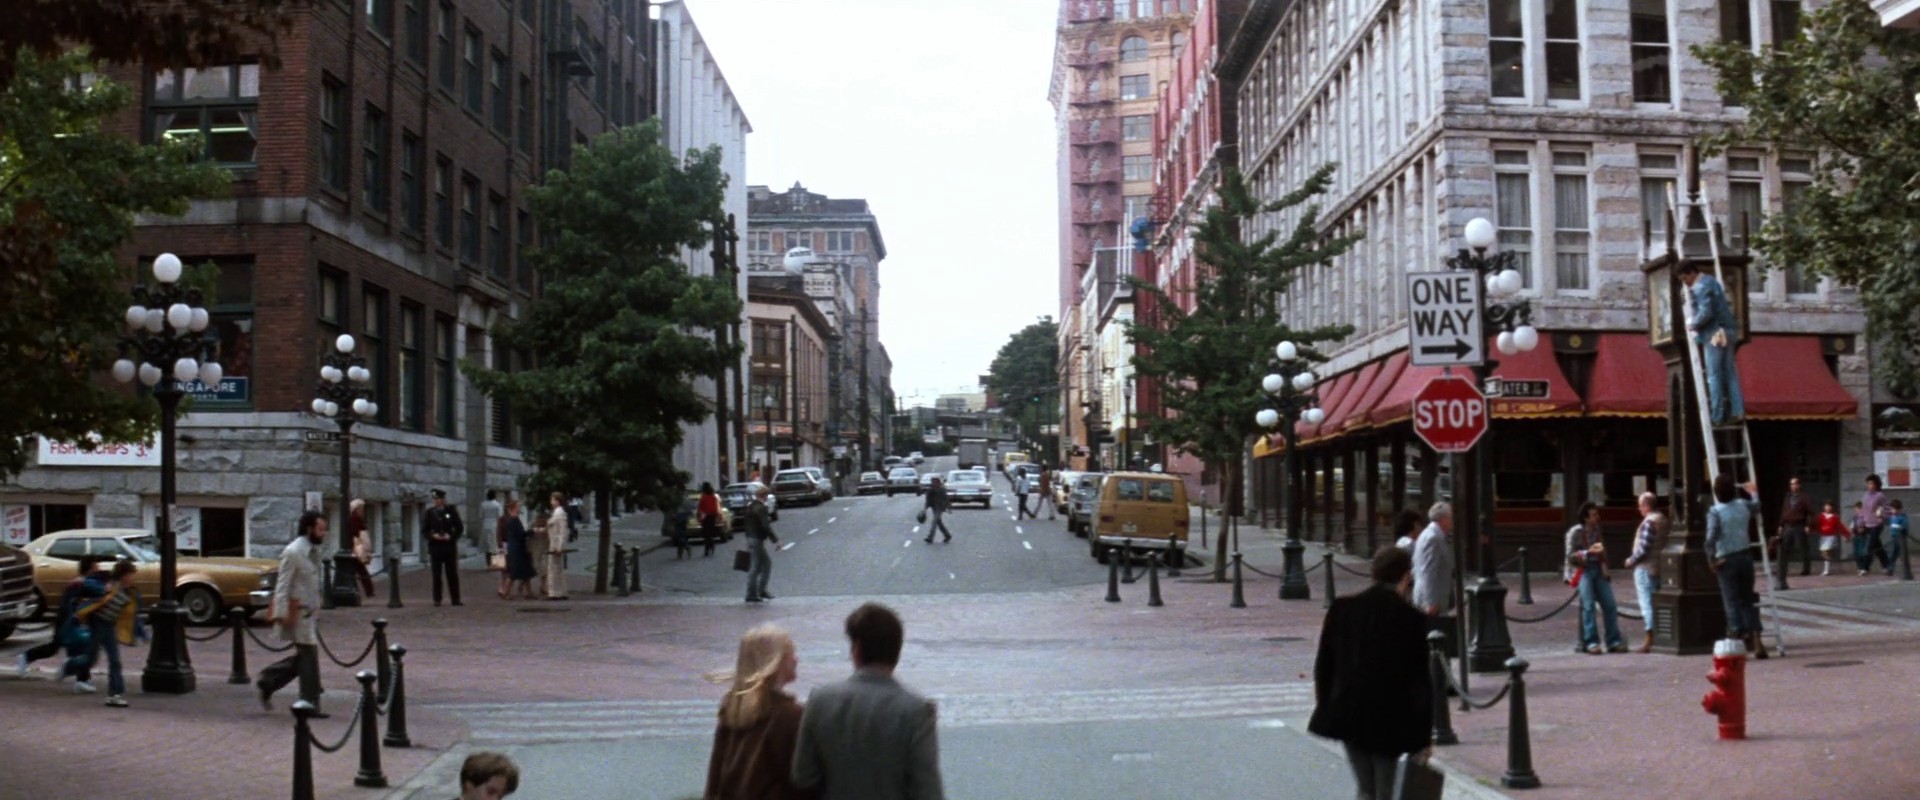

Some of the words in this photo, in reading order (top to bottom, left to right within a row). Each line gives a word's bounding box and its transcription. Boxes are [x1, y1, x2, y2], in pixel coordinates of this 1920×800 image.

[1412, 277, 1473, 306] ONE
[1413, 309, 1475, 337] WAY
[1503, 382, 1530, 395] ATER
[1416, 399, 1482, 429] STOP
[50, 441, 77, 455] FISH
